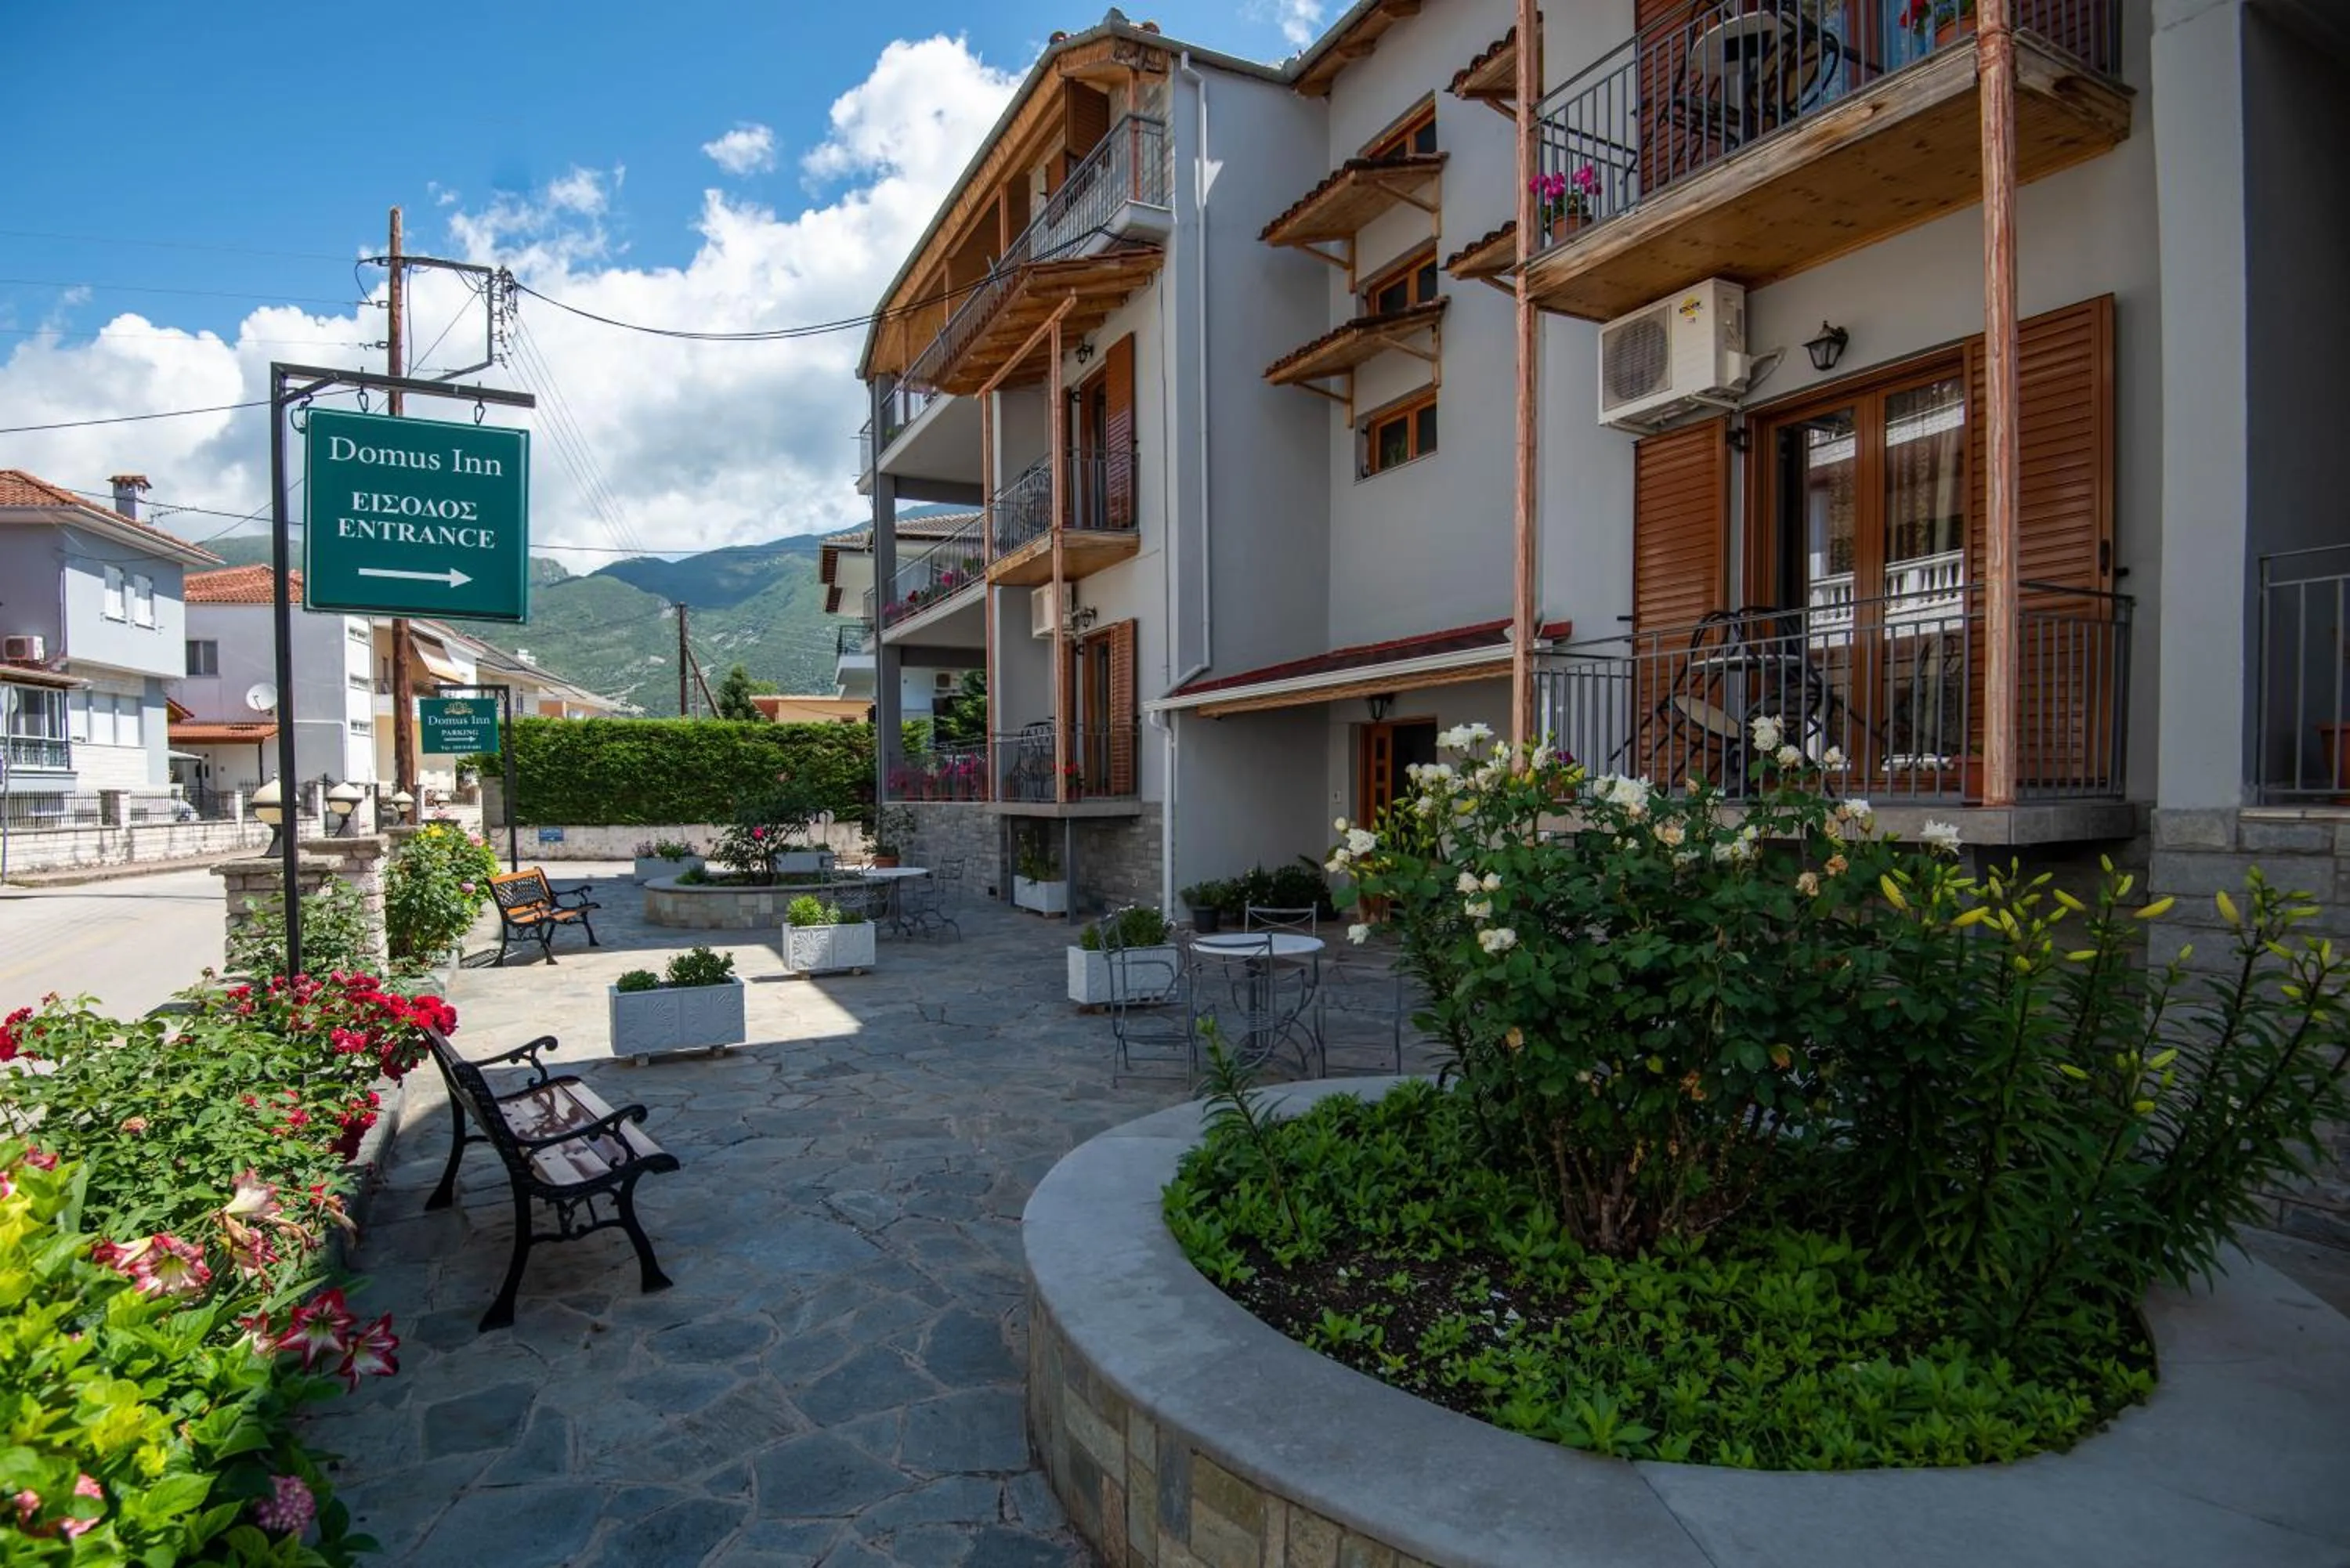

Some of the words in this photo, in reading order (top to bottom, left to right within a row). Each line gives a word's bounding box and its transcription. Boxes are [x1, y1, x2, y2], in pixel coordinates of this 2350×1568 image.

[329, 436, 441, 470] Domus
[452, 449, 503, 476] Inn
[352, 491, 478, 521] ΕΙΣΟΔΟΣ
[338, 518, 496, 549] ENTRANCE
[428, 716, 468, 725] Domus
[472, 716, 490, 724] Inn
